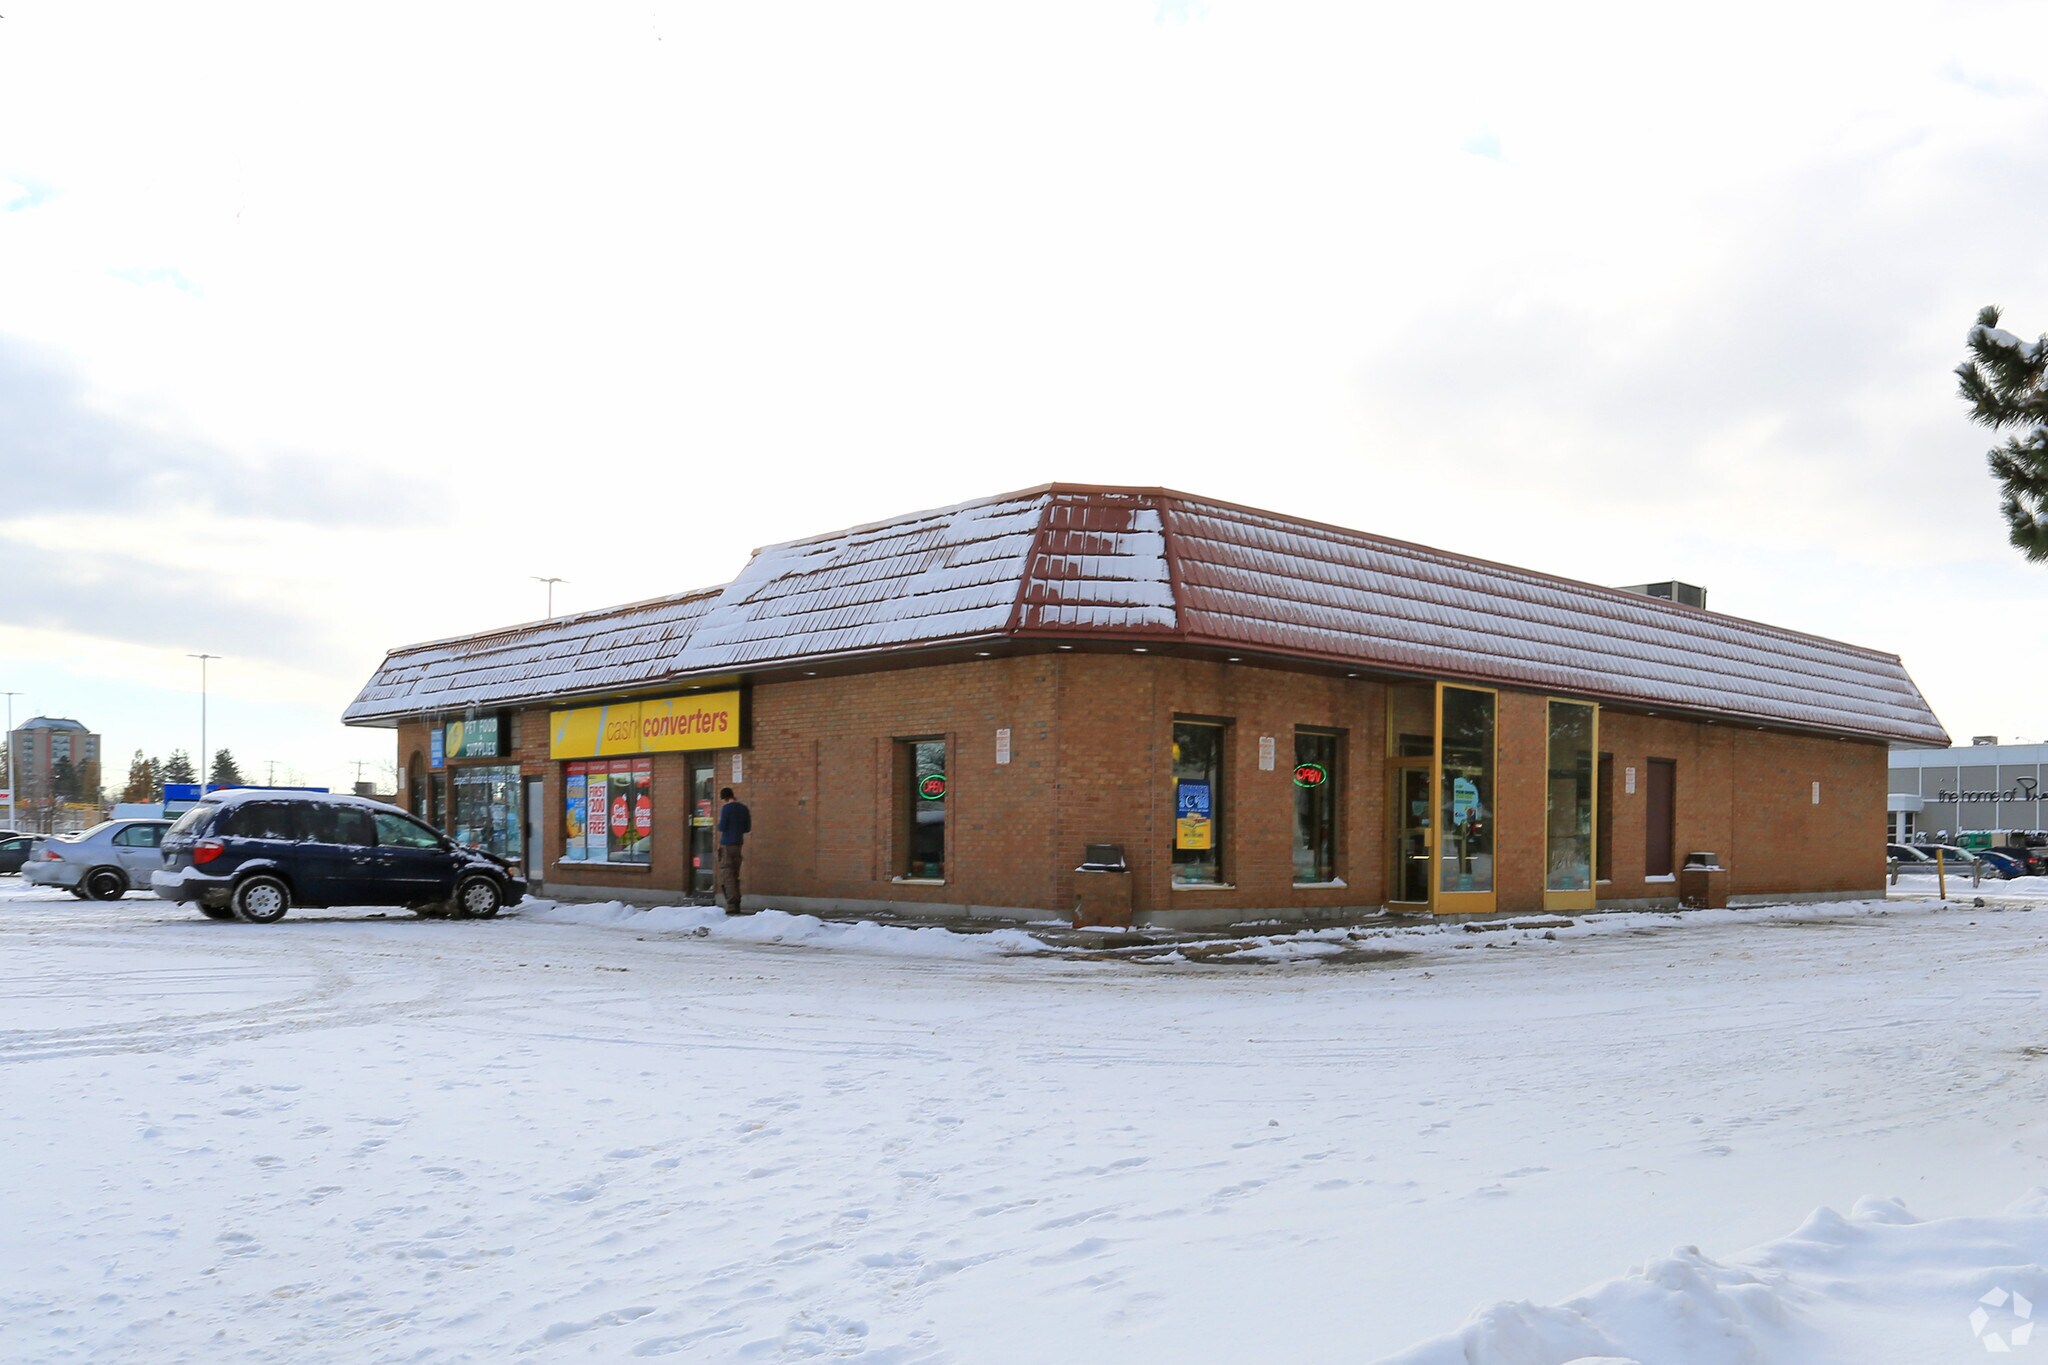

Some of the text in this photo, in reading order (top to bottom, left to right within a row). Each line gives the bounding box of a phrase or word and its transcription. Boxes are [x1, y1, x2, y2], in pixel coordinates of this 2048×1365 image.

[465, 718, 497, 734] PET FOOD
[606, 709, 727, 740] cash converters
[466, 742, 496, 757] SUPPLIES
[1296, 767, 1322, 783] OPEN
[589, 786, 606, 797] FIRST
[923, 780, 944, 793] OPEN
[1938, 788, 1958, 803] the
[1962, 788, 2000, 803] home
[2003, 787, 2017, 803] of
[589, 821, 606, 834] FREE
